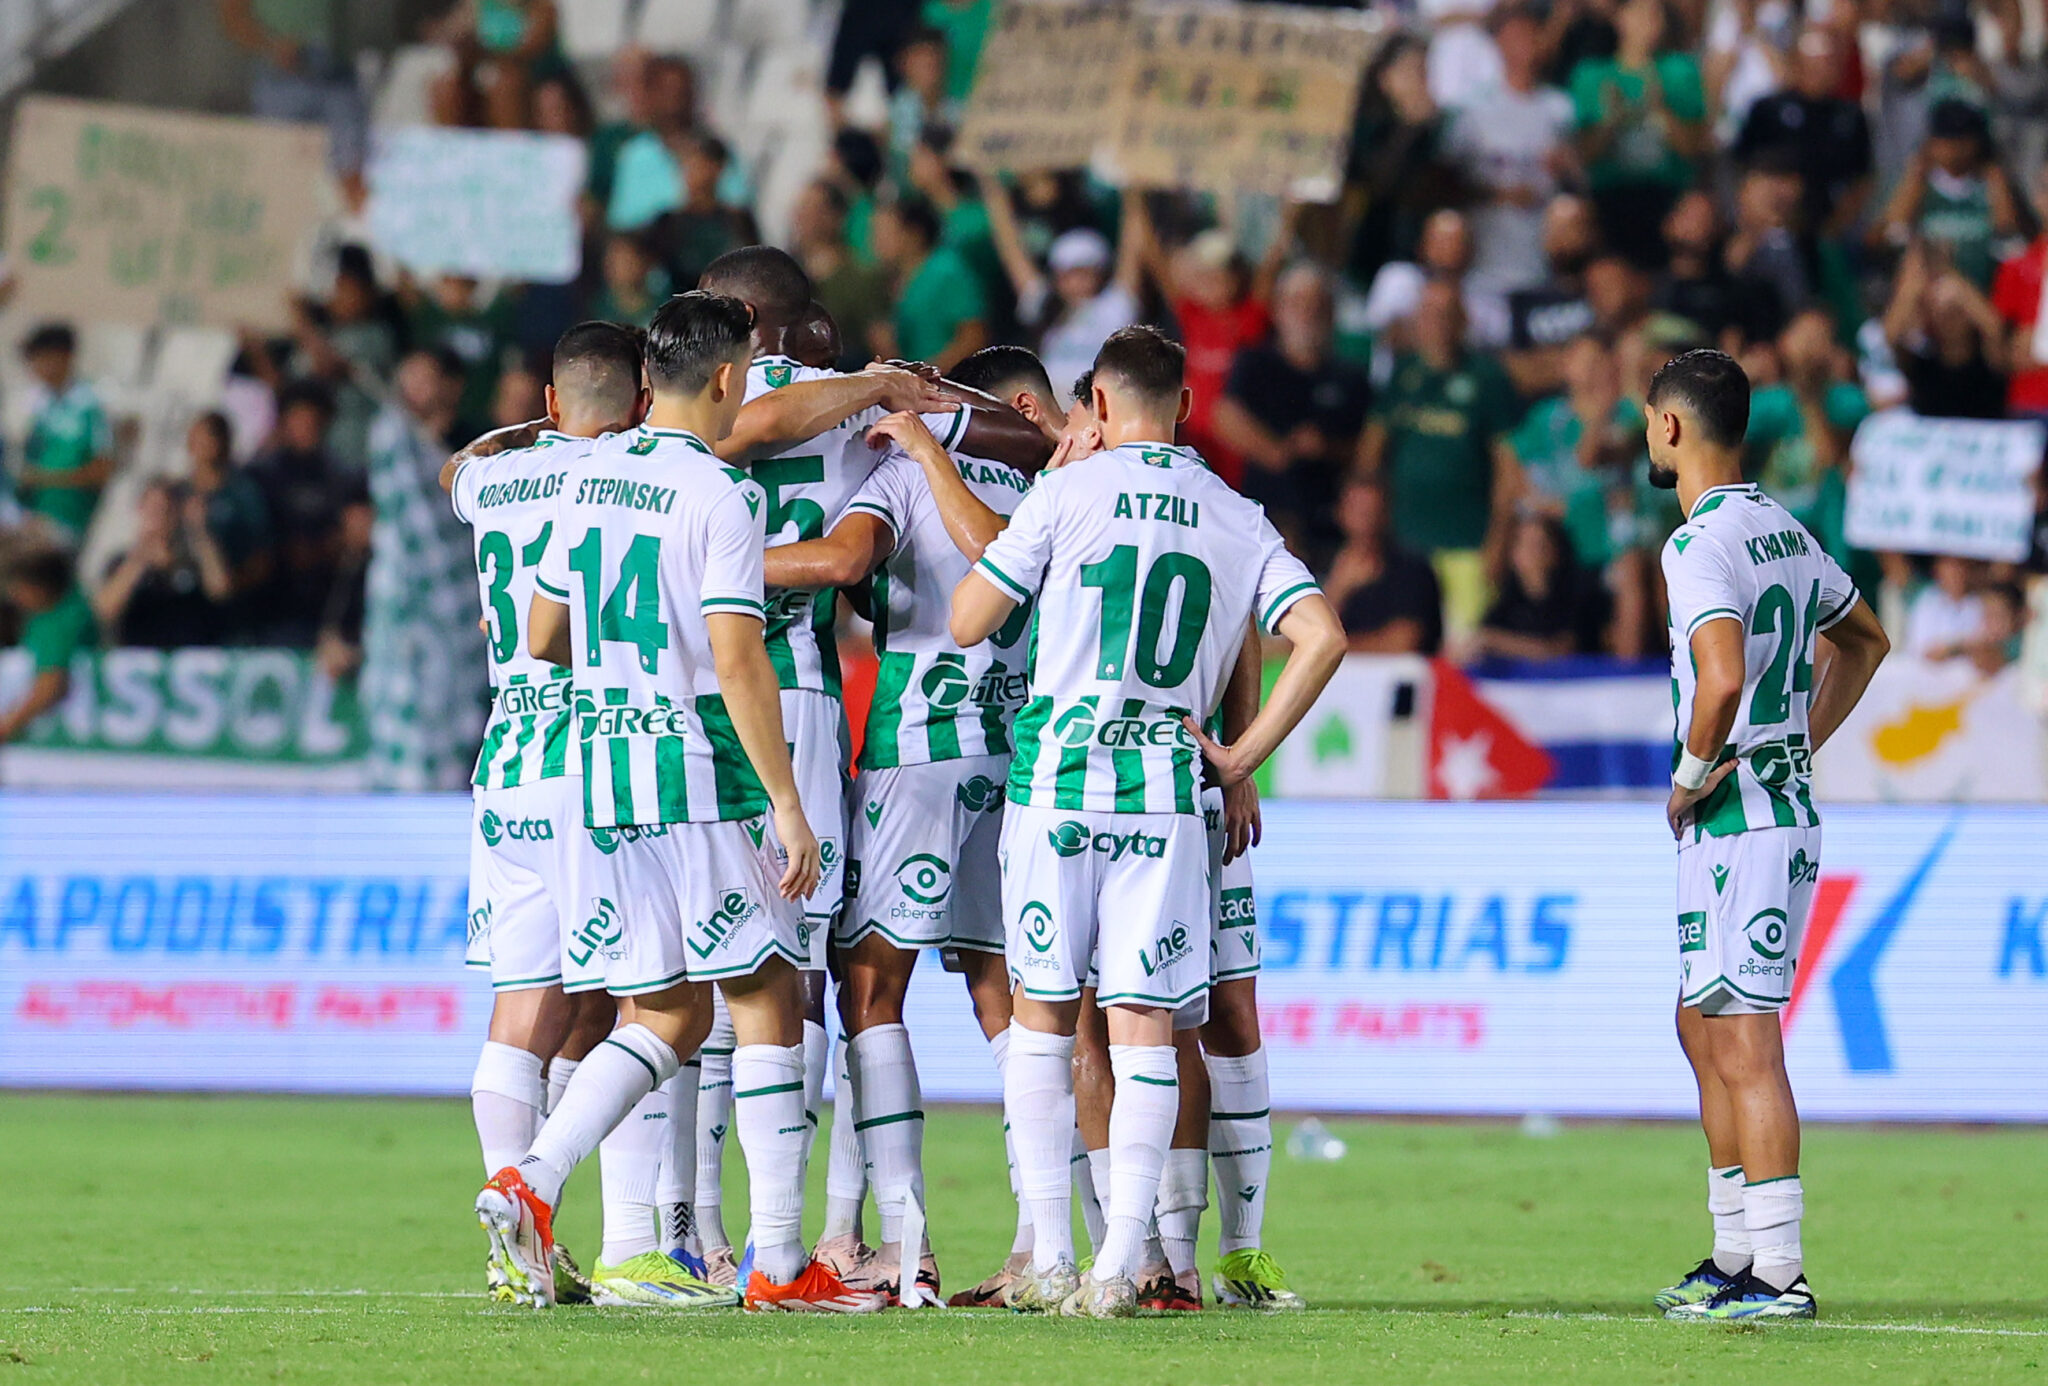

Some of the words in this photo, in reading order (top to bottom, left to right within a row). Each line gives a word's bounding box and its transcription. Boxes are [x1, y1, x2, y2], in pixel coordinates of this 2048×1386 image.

[576, 479, 676, 514] STEPINSKI
[1113, 493, 1199, 528] ATZILI
[569, 527, 668, 675] 14
[1080, 544, 1211, 688] 10
[599, 707, 687, 735] GREE
[1097, 719, 1197, 749] GREE
[506, 815, 554, 842] cta
[1092, 829, 1167, 861] cyta
[686, 892, 747, 960] Line
[720, 902, 761, 950] promotions
